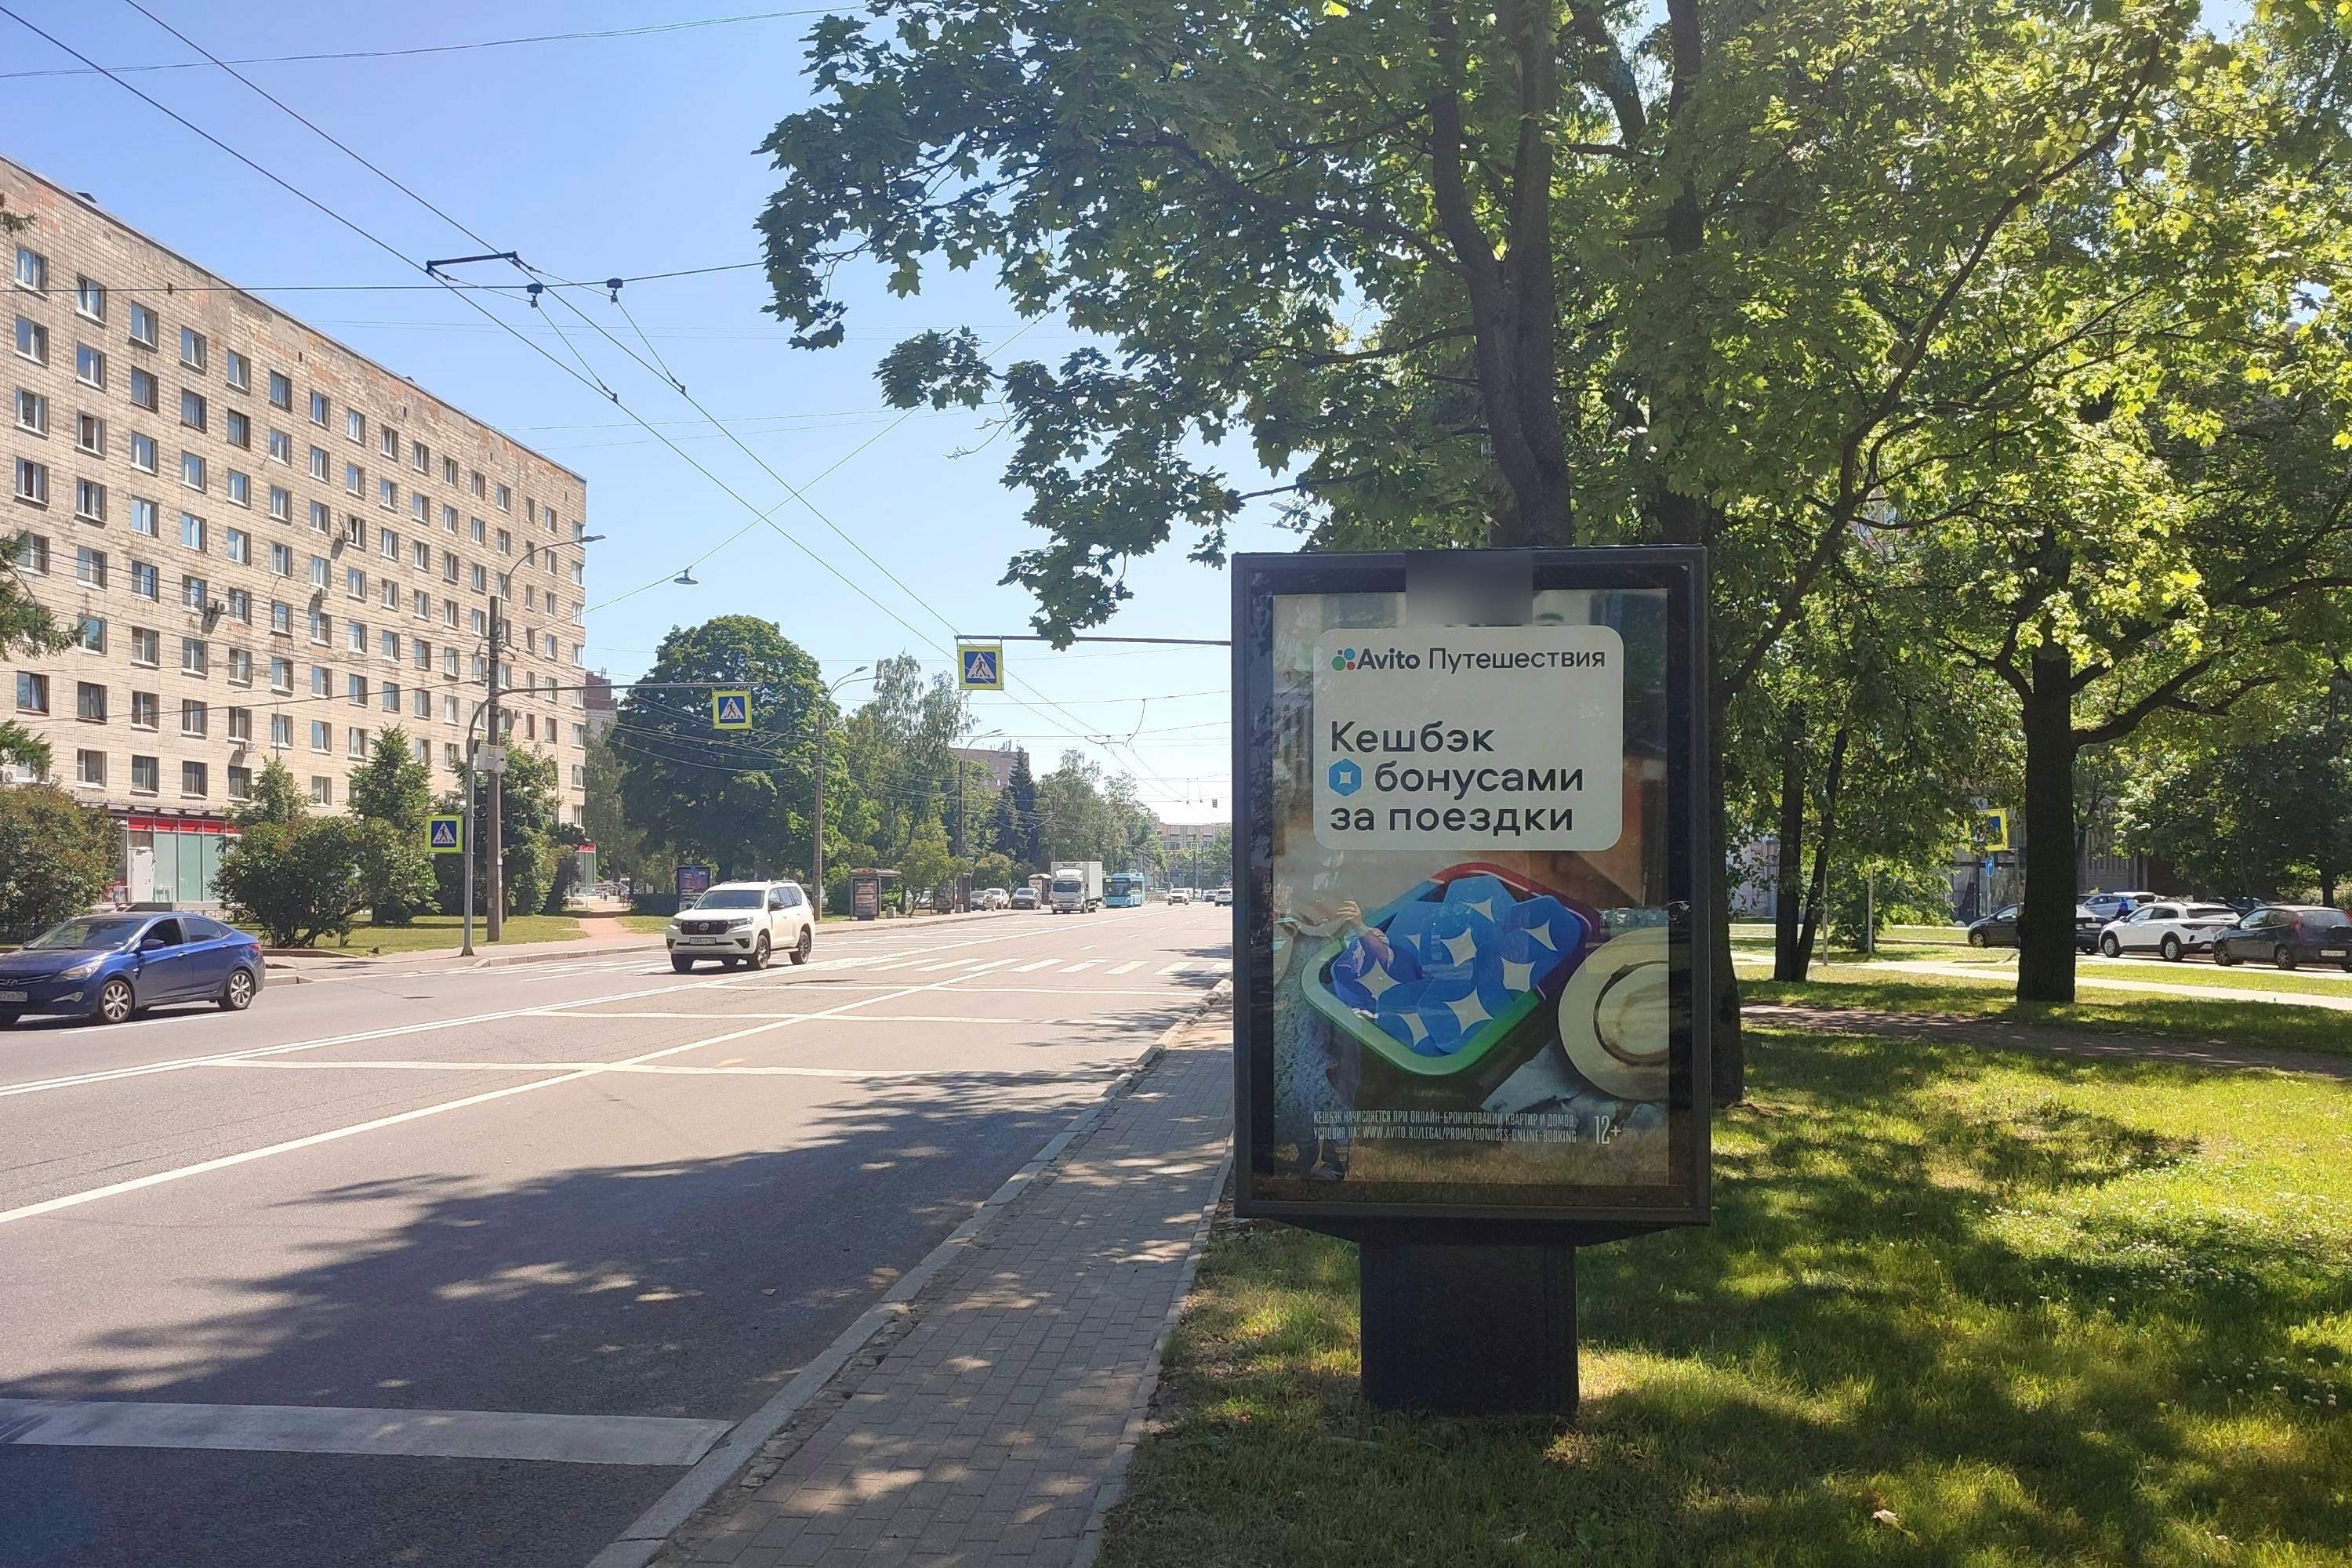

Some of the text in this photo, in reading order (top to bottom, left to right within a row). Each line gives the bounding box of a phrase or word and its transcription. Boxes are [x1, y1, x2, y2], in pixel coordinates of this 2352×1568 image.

[1356, 648, 1606, 674] Avito Путешествия
[1331, 720, 1495, 753] Кешбэк
[1374, 760, 1583, 800] бонусами
[1330, 808, 1573, 837] за поездки
[1313, 1110, 1342, 1124] КЕШБЭК
[1344, 1110, 1390, 1123] НАЧИСЛЯЕТСЯ
[1393, 1110, 1408, 1123] ПРИ
[1410, 1109, 1503, 1126] ОНЛАЙН-БРОНИРОВАНИИ
[1505, 1112, 1537, 1127] КВАРТИР
[1540, 1113, 1545, 1126] И
[1594, 1115, 1622, 1145] 12+
[1313, 1127, 1345, 1141] УСЛОВИЯ
[1348, 1126, 1360, 1139] НА:
